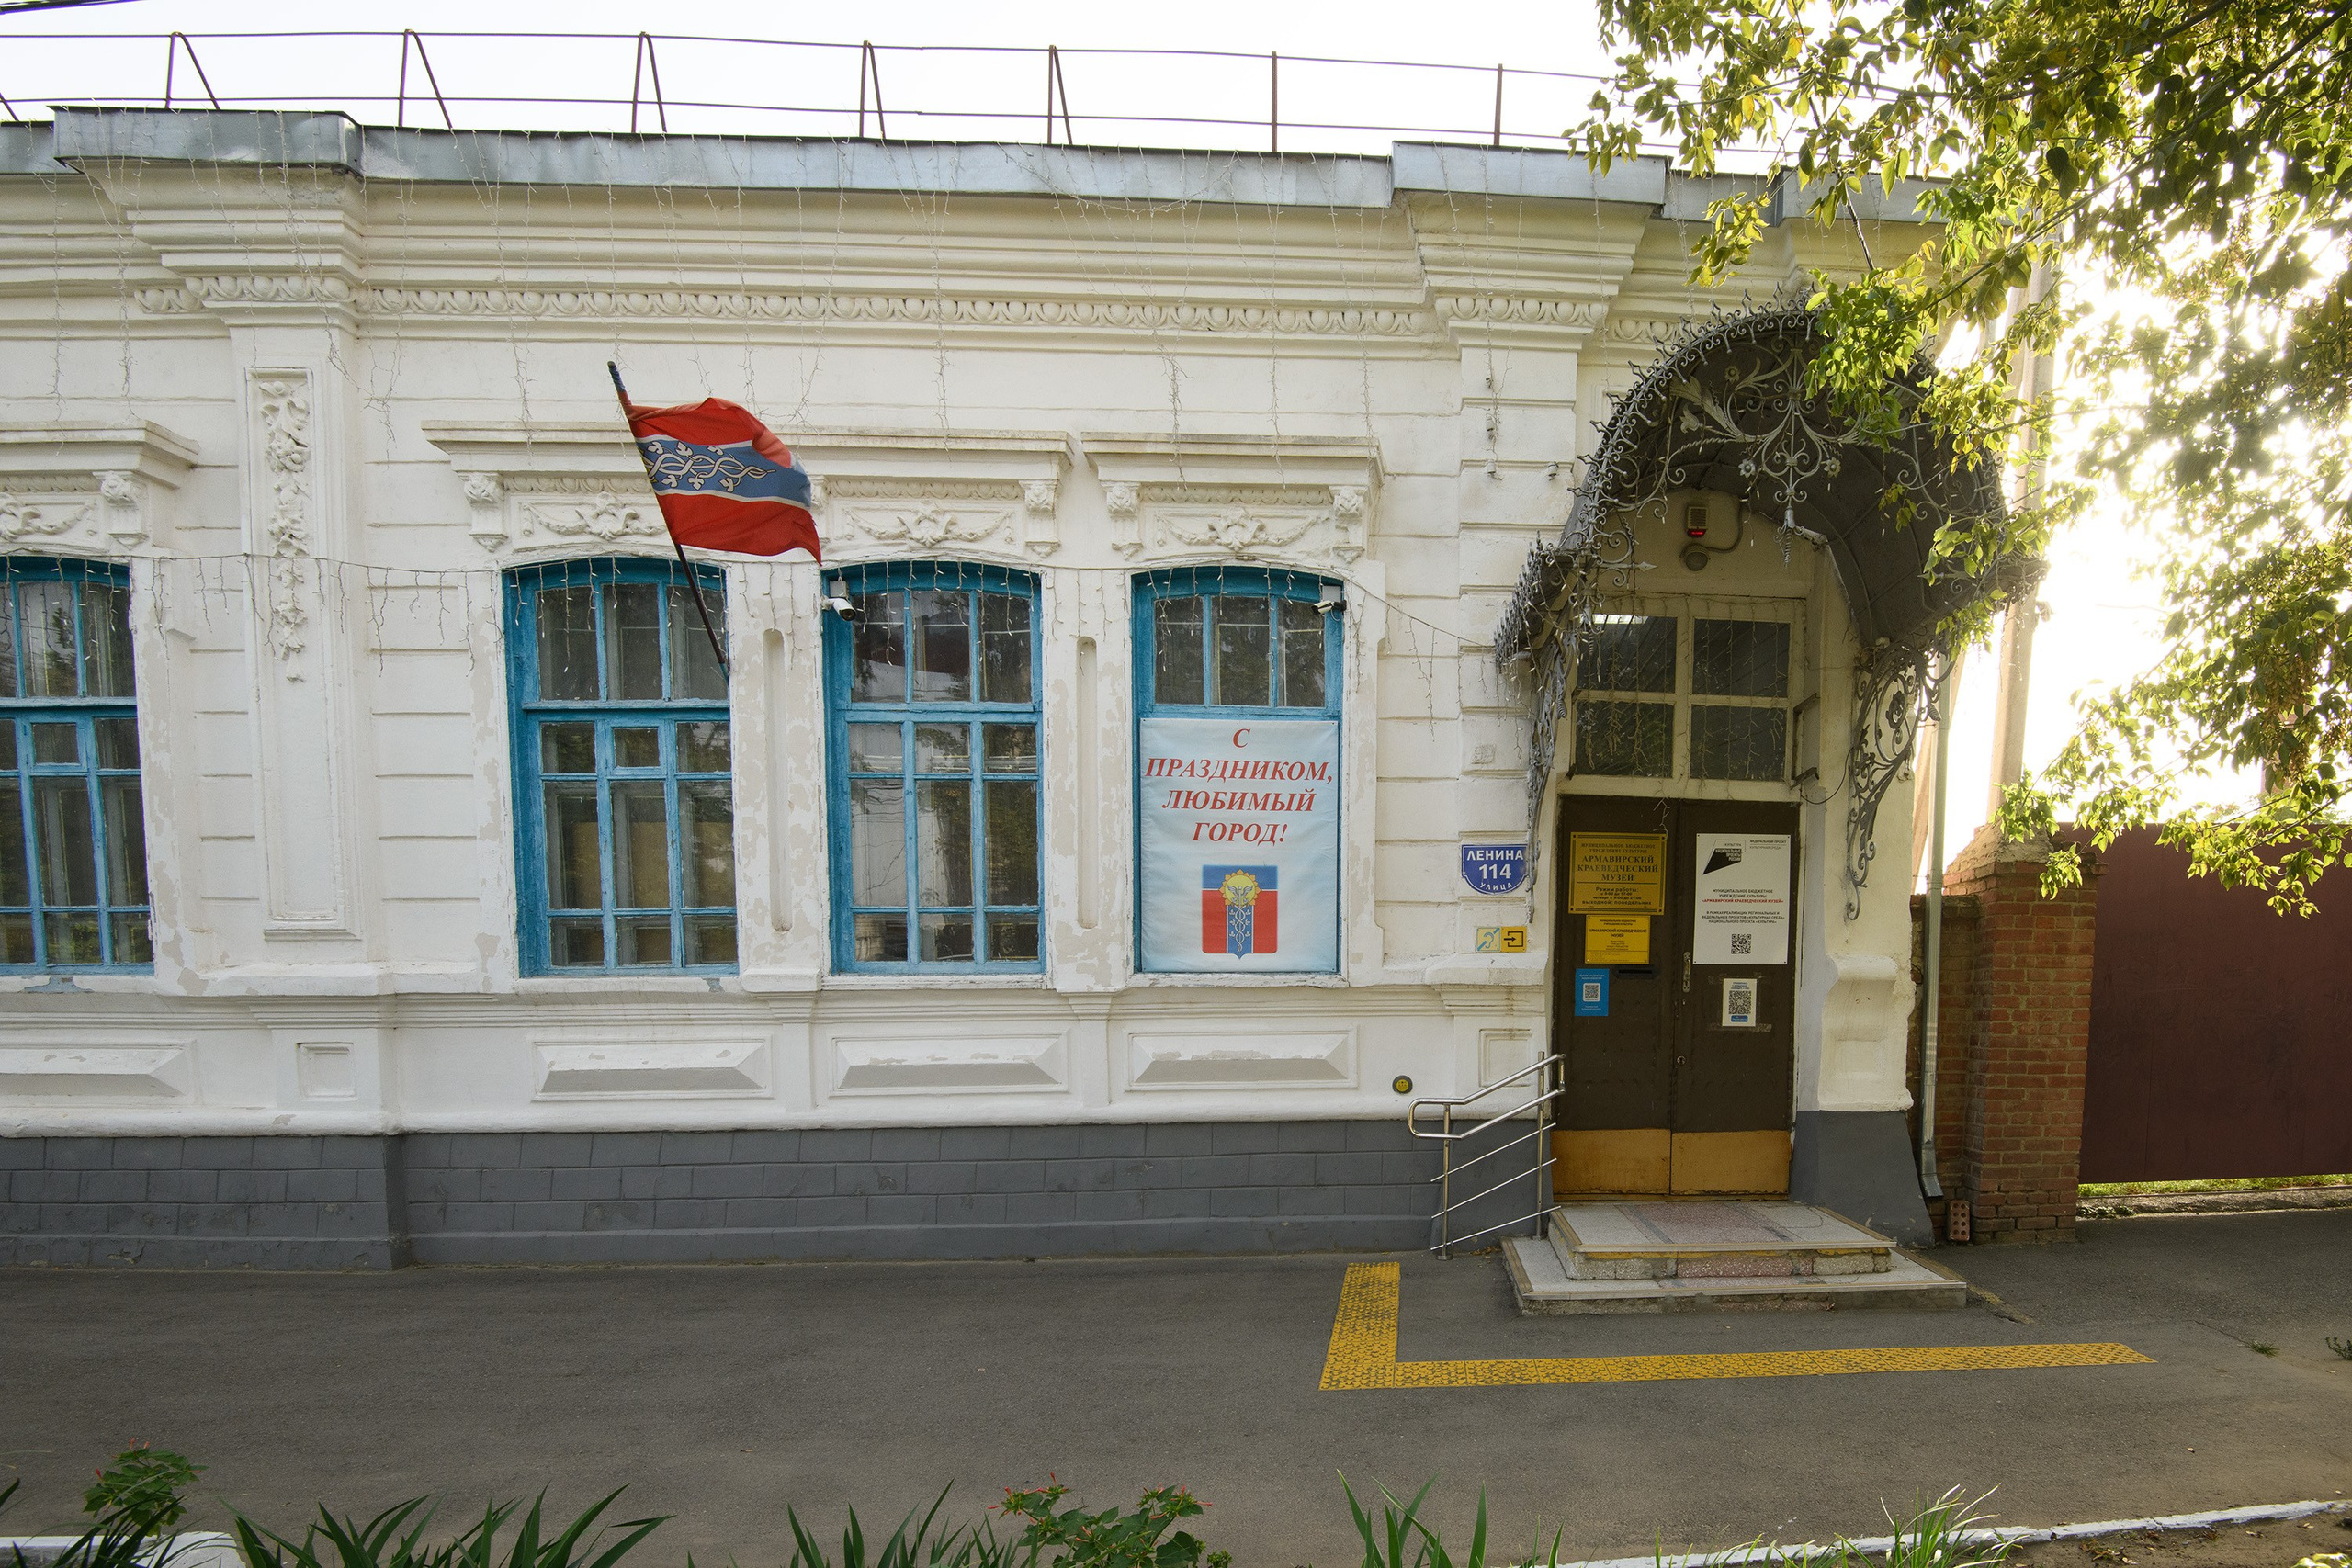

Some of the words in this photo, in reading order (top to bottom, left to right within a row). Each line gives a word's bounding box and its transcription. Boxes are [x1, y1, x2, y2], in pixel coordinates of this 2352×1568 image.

[1232, 728, 1251, 749] С
[1144, 758, 1333, 784] ПРАЗДНИКОМ,
[1161, 788, 1317, 812] ЛЮБИМЫЙ
[1191, 822, 1288, 846] ГОРОД!
[1466, 850, 1524, 861] ЛЕНИНА
[1478, 863, 1512, 880] 114
[1577, 864, 1658, 873] КРАЕВЕДЧЕСКИЙ
[1479, 882, 1513, 891] УЛИЦА
